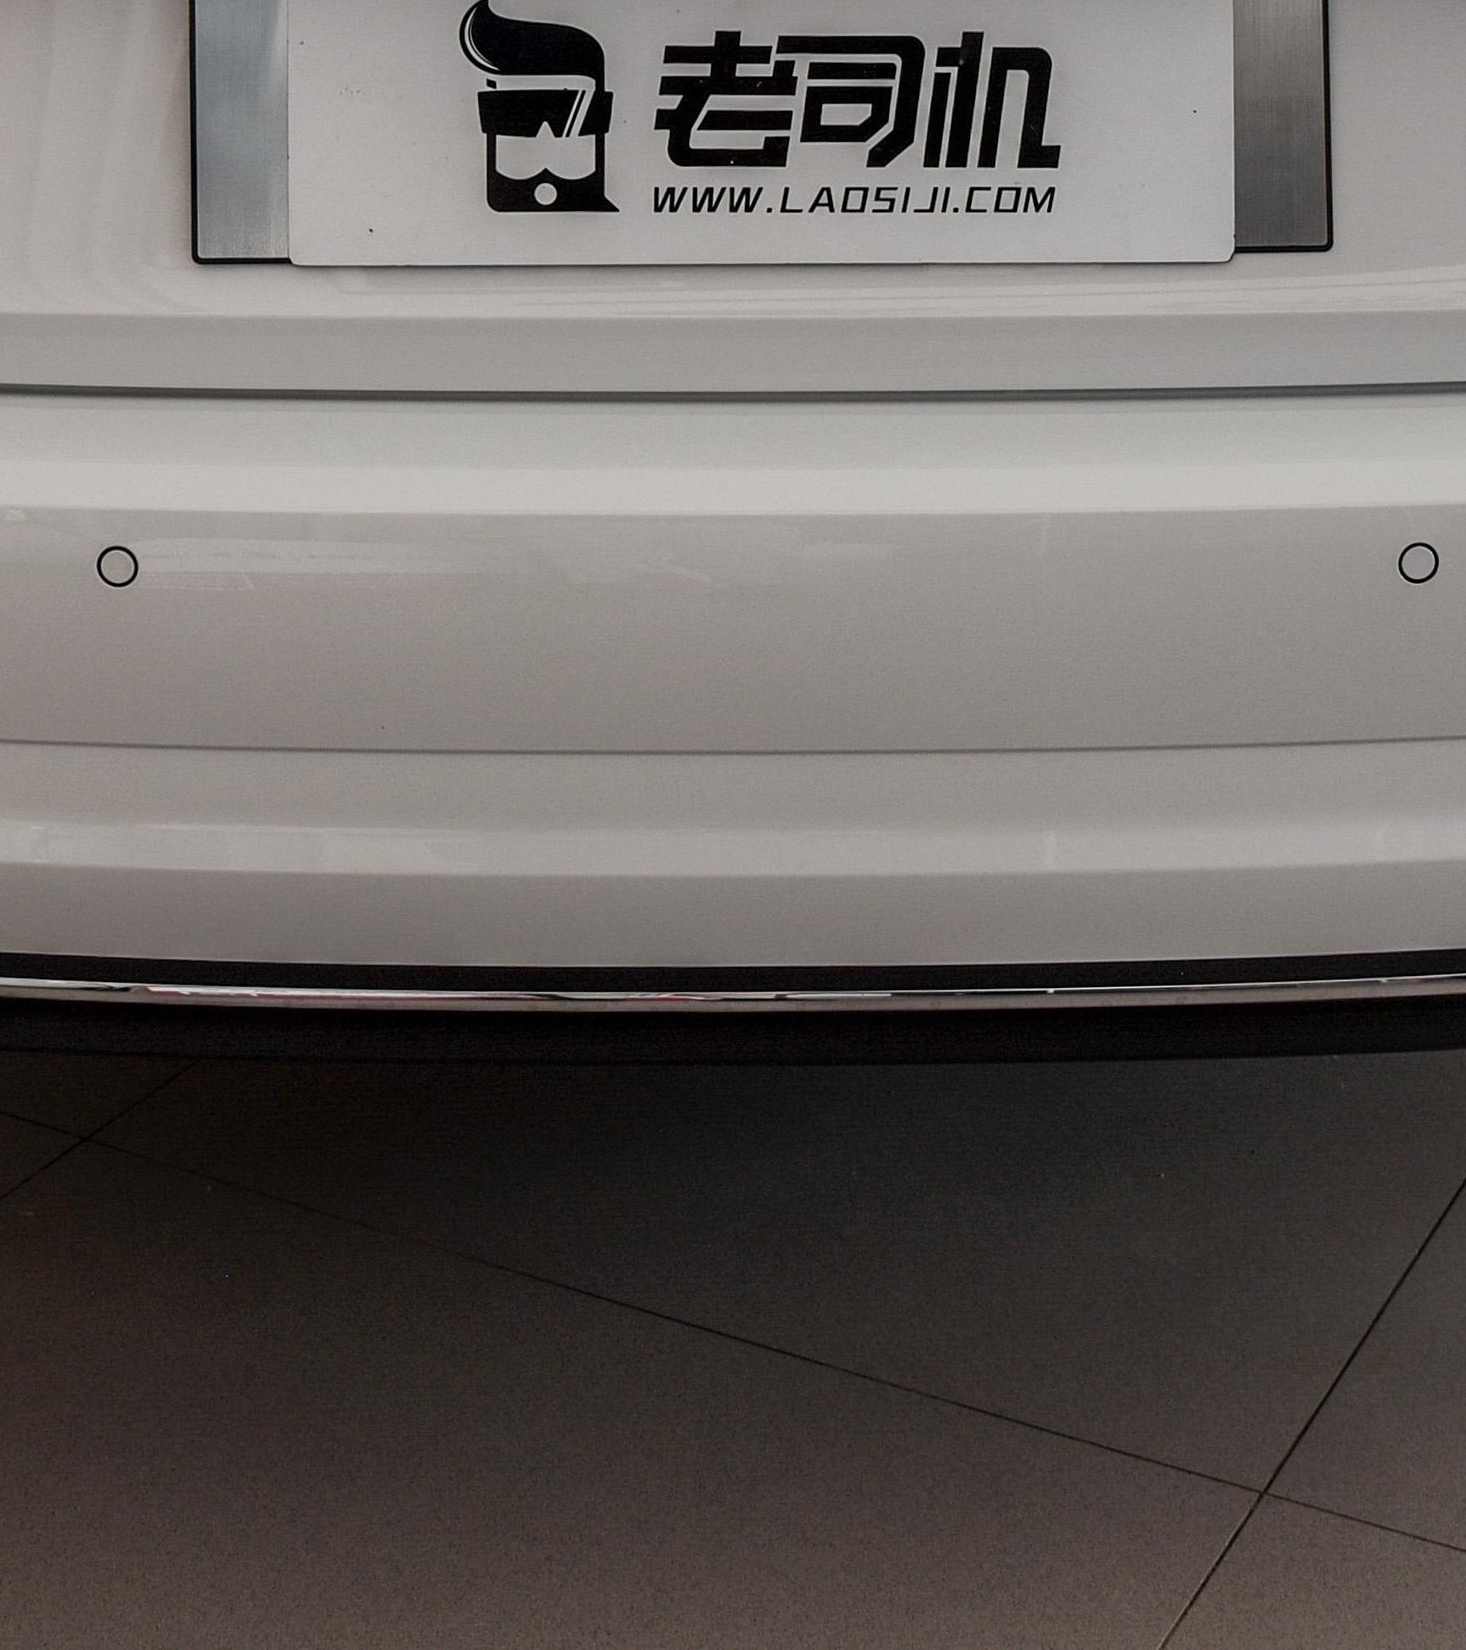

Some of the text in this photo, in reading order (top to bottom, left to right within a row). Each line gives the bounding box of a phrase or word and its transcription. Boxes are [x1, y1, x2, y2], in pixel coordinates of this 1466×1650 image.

[653, 30, 1062, 169] 老司机
[652, 186, 1057, 214] WWW.LAOSIJI.COM
